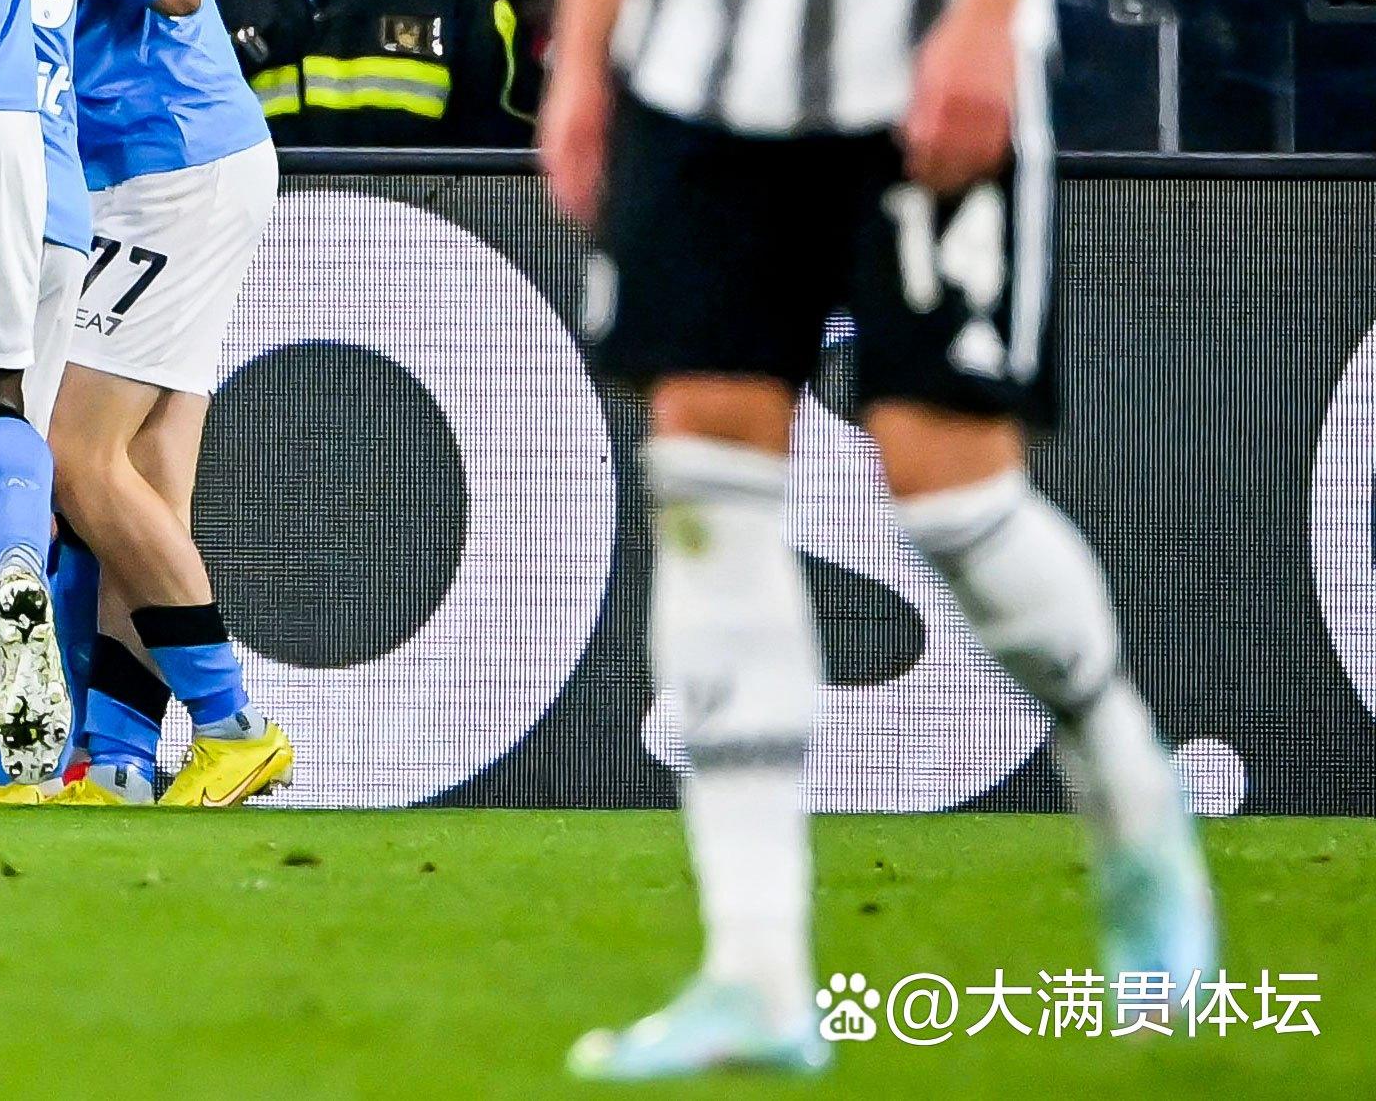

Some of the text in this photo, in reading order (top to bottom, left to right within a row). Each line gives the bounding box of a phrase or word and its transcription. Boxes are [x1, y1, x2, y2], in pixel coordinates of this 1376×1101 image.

[78, 235, 168, 315] 77
[877, 182, 1006, 315] 14
[74, 308, 124, 336] EA7
